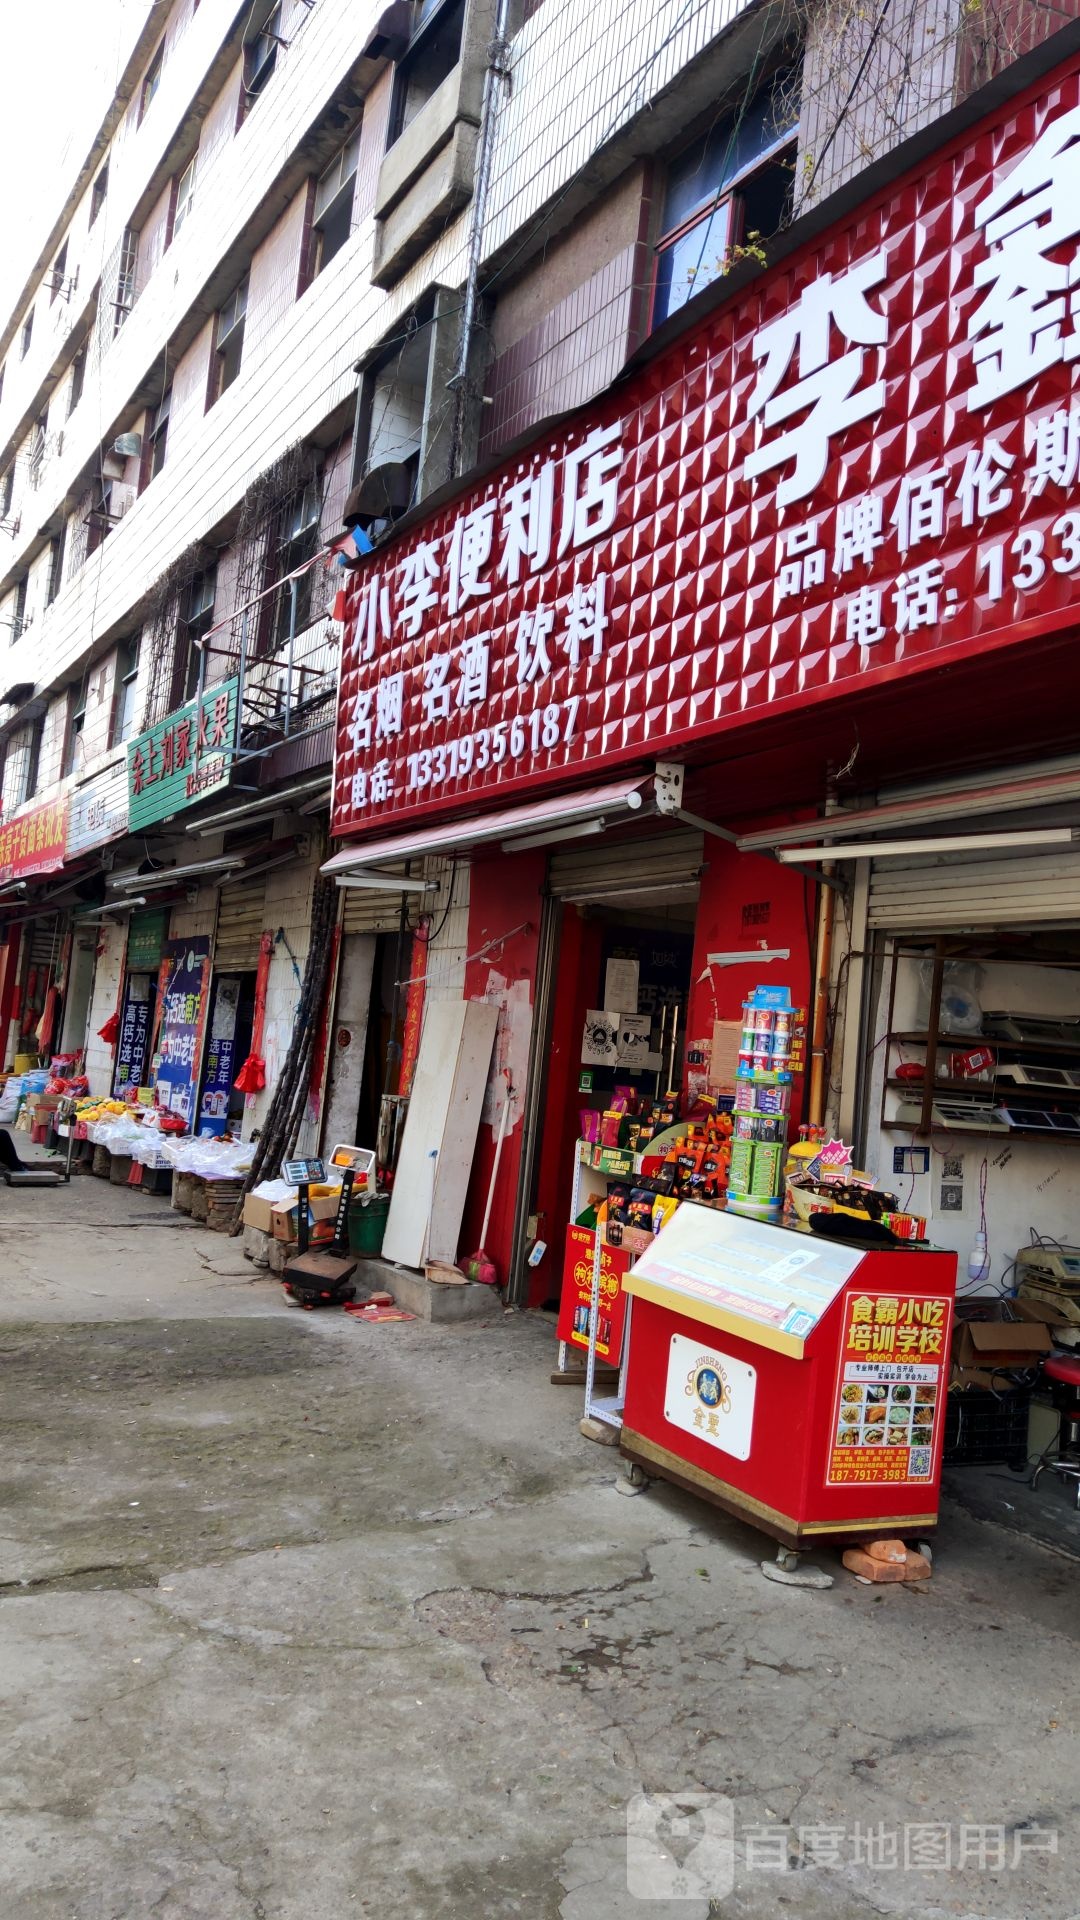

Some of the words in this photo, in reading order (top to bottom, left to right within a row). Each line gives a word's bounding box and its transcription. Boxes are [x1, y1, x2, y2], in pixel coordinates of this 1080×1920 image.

[350, 420, 624, 663] 小李便利店
[406, 695, 581, 790] 13319356187
[161, 1034, 197, 1065] 为中老年
[850, 1295, 946, 1327] 食霸小吃
[846, 1324, 943, 1355] 培训学校
[830, 1469, 906, 1481] 187-7917-3983
